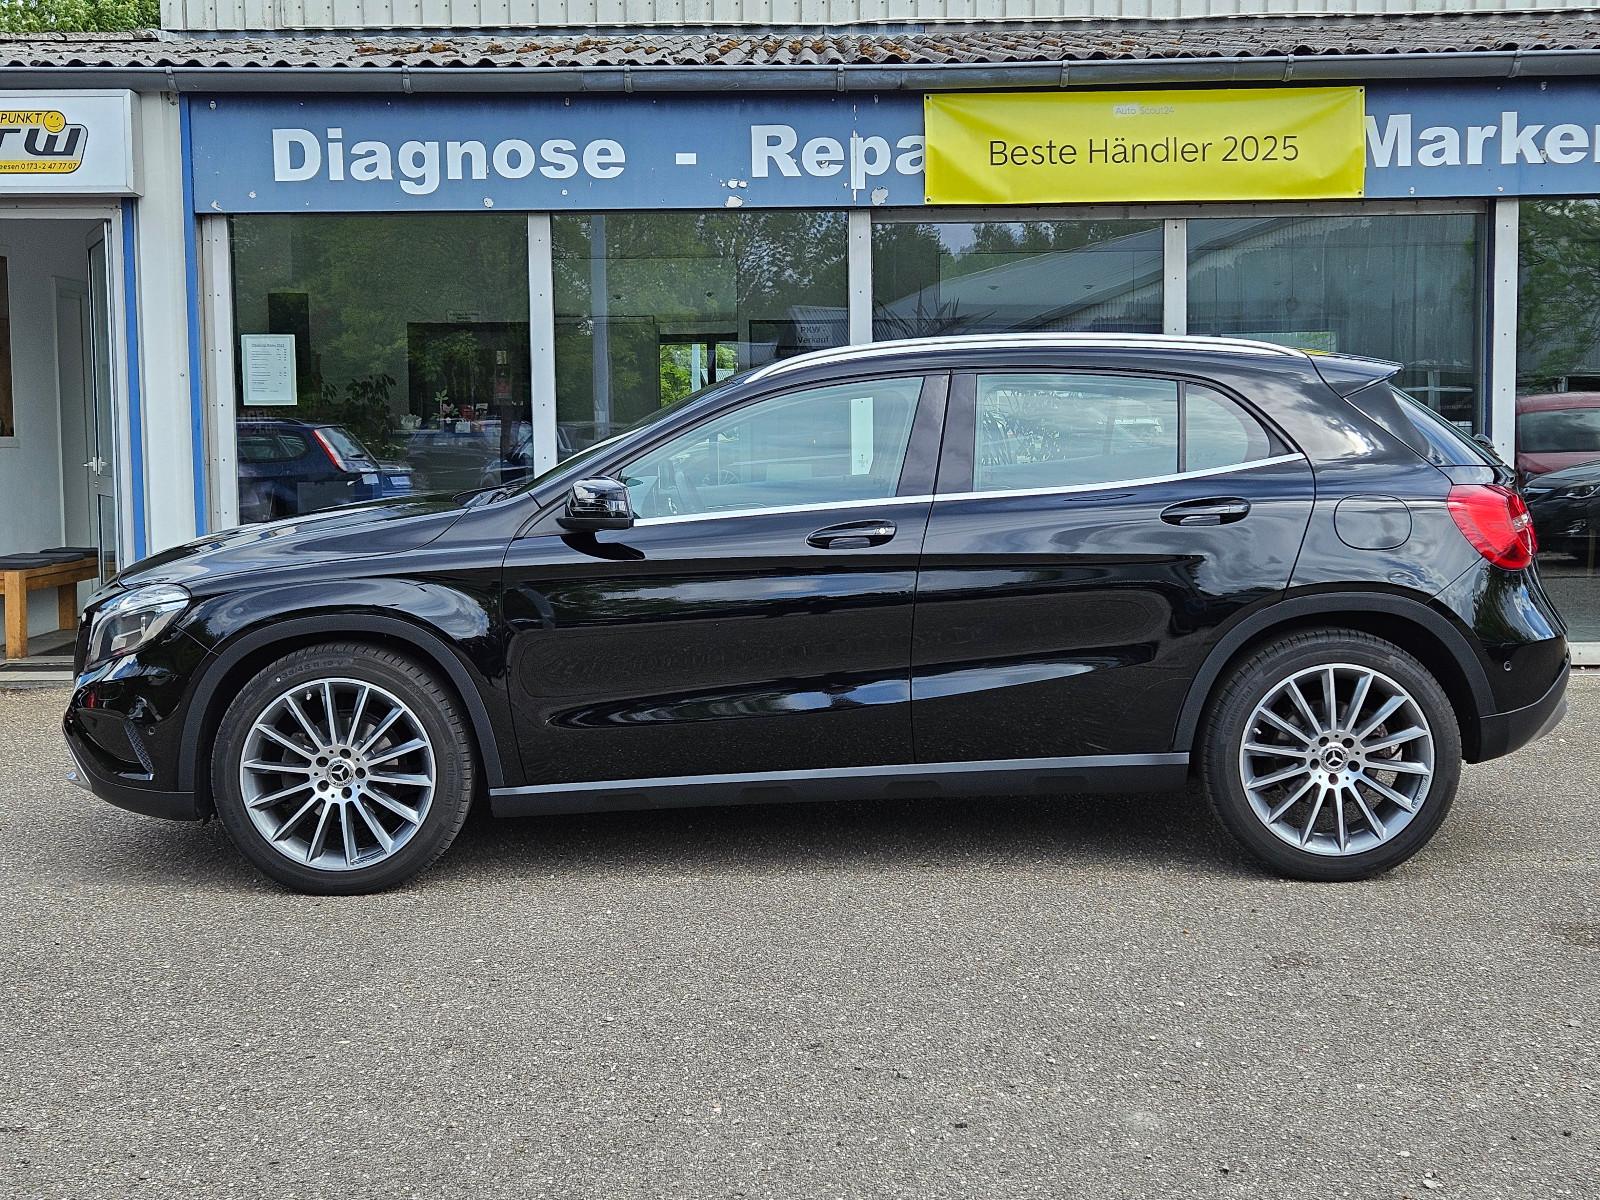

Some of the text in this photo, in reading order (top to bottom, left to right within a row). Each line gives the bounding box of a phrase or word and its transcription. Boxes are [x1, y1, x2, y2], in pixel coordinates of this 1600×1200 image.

[0, 113, 42, 124] PUNKT
[990, 135, 1299, 166] Beste Händler 2025
[1364, 111, 1600, 168] Marke
[272, 125, 925, 195] Diagnose - Repa
[797, 336, 829, 344] Verkauf
